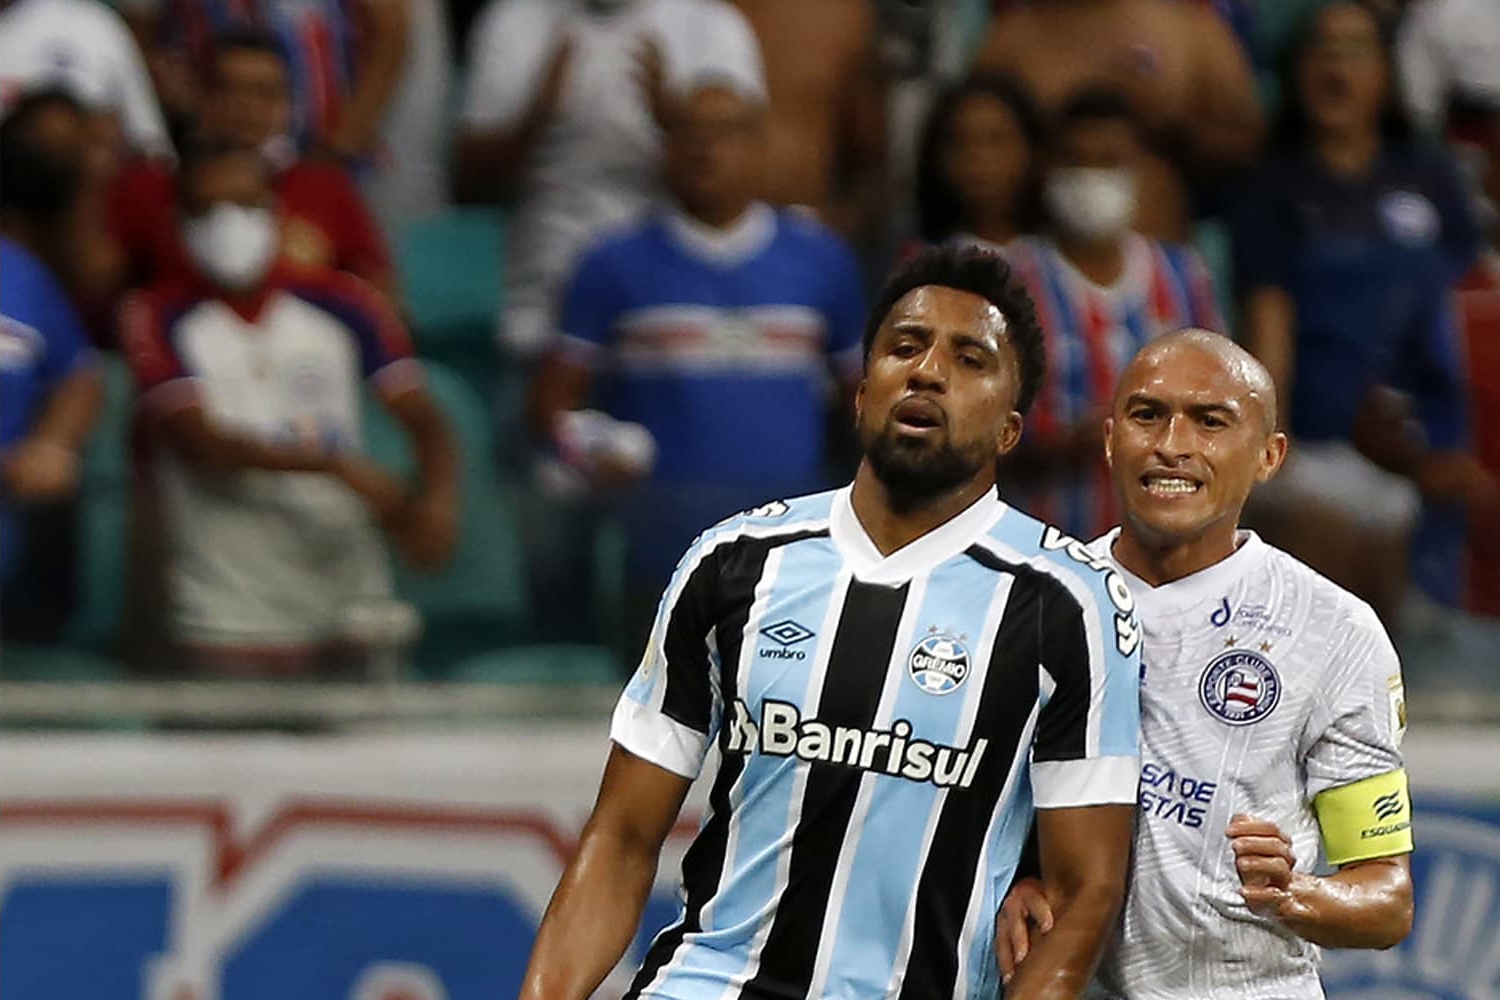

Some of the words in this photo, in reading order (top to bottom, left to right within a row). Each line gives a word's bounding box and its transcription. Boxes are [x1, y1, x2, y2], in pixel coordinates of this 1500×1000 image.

[760, 648, 806, 660] umbro
[762, 702, 988, 788] Banrisul
[1181, 778, 1217, 803] DE
